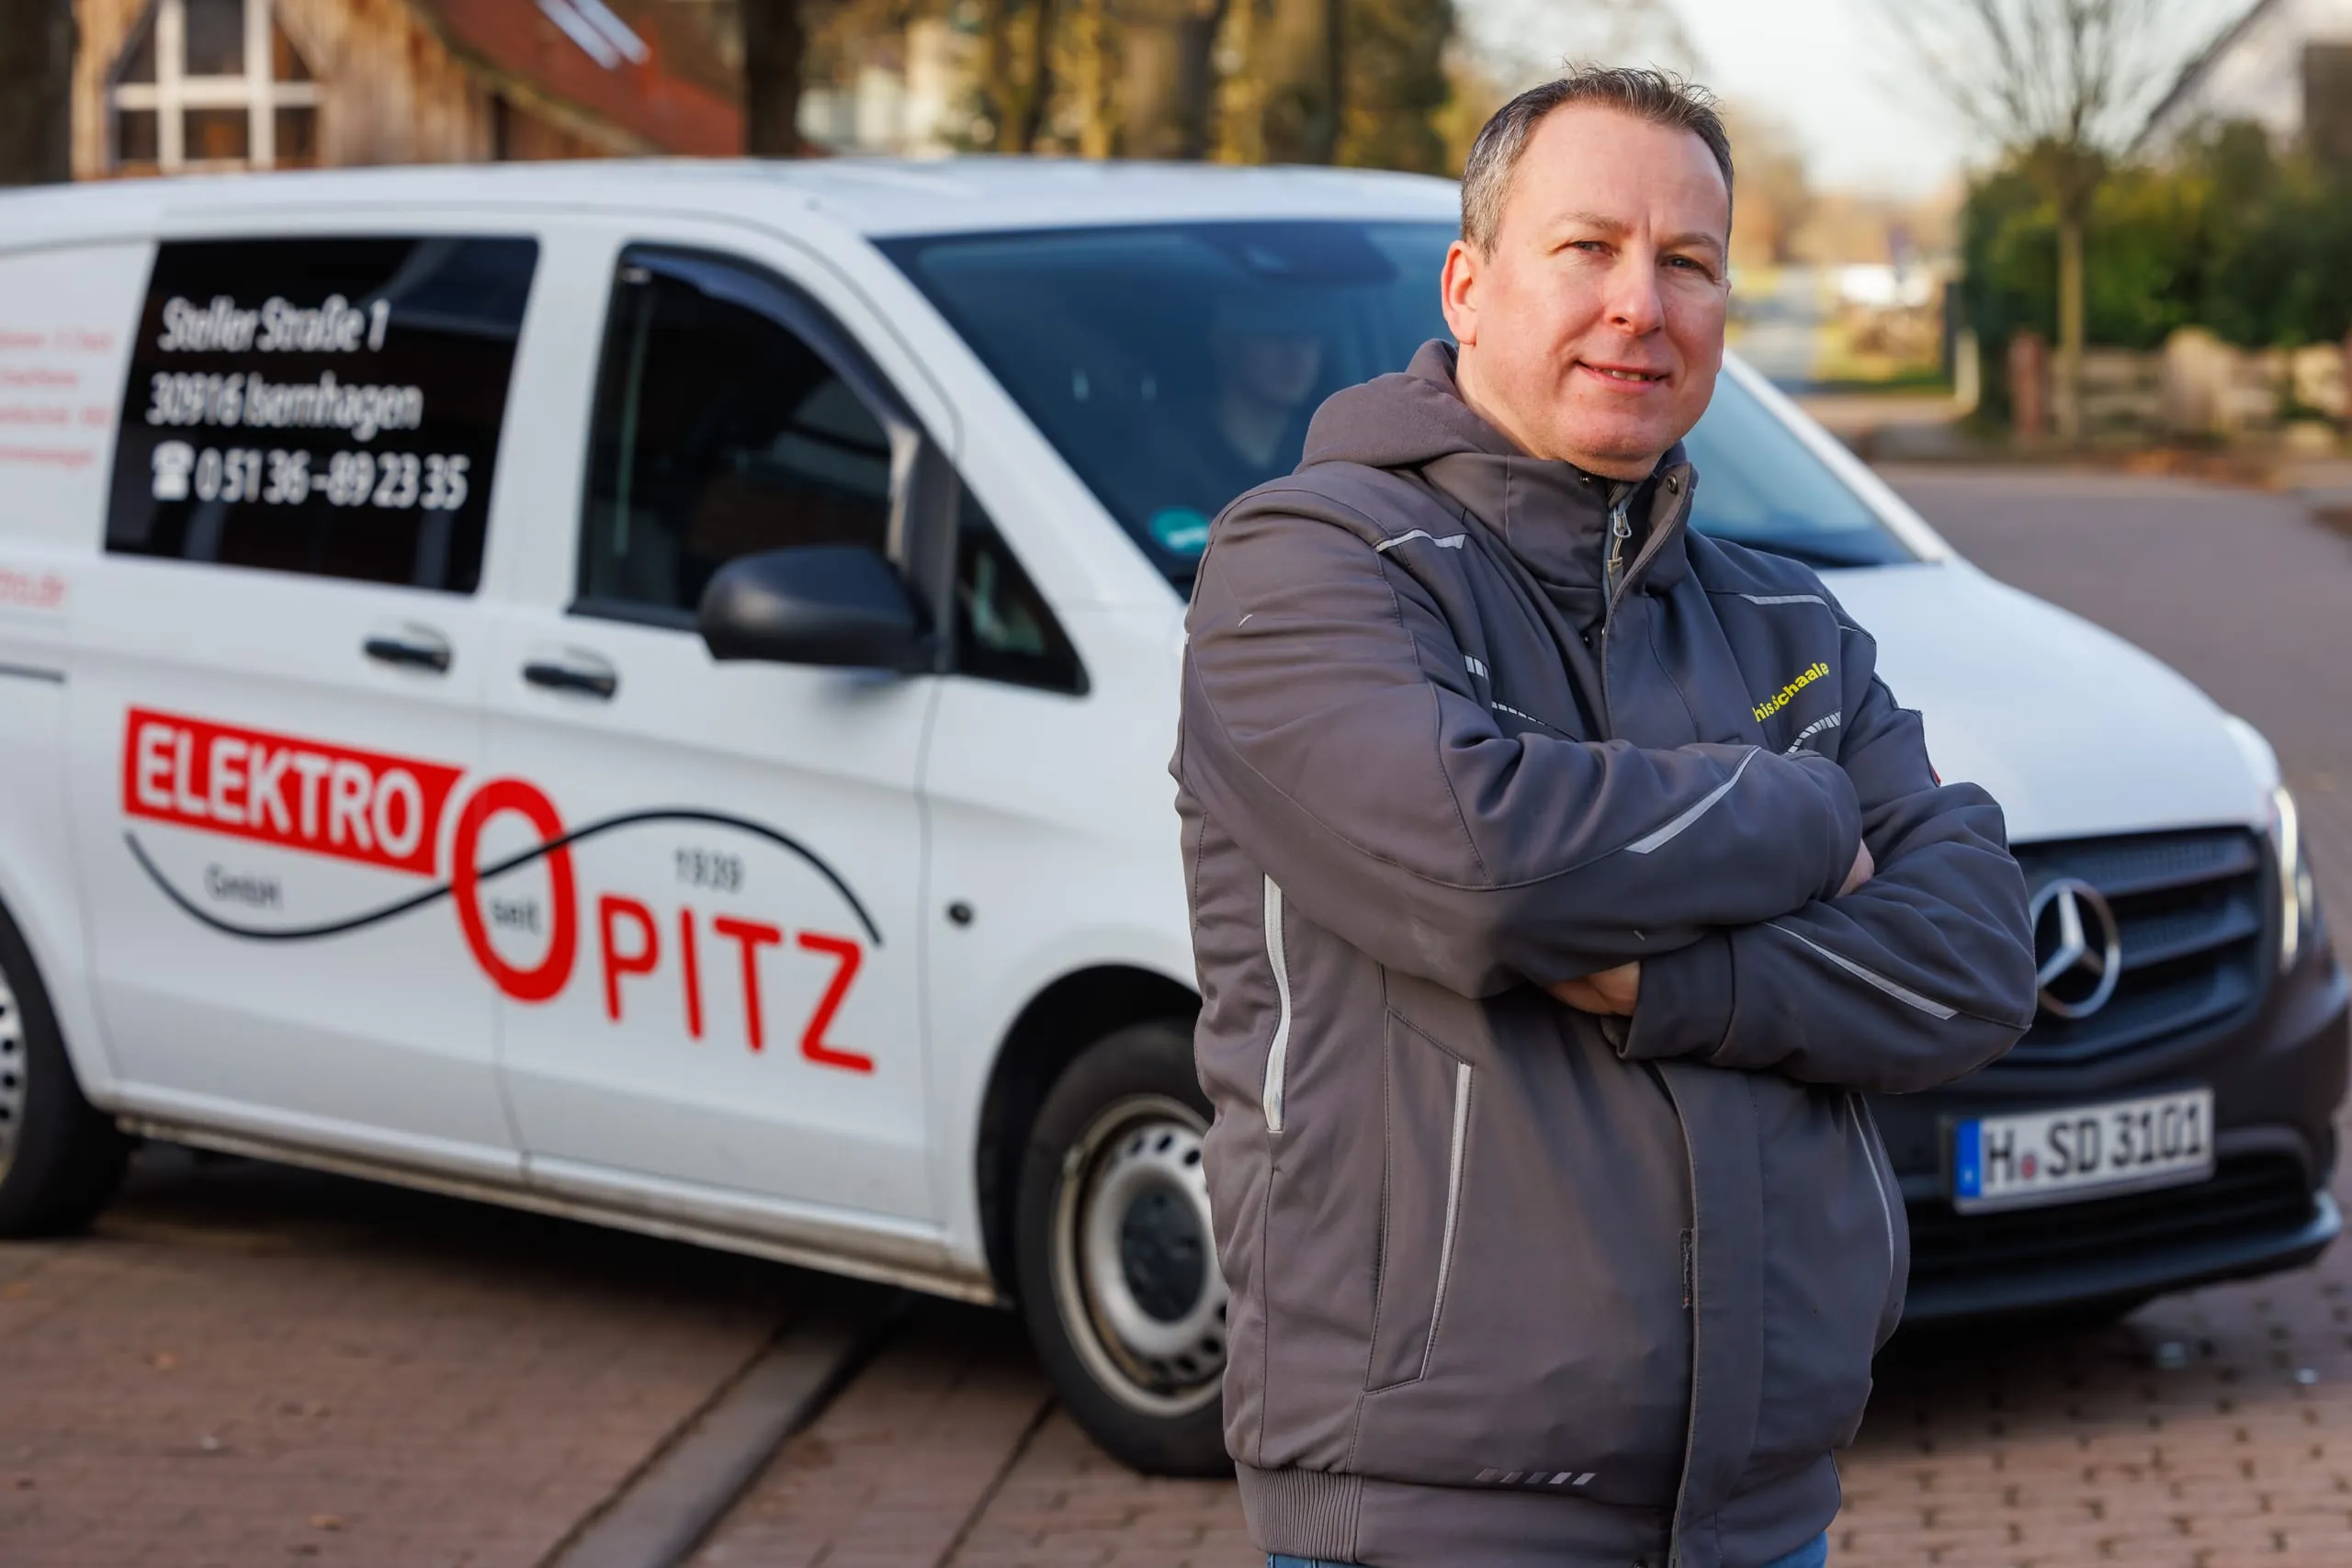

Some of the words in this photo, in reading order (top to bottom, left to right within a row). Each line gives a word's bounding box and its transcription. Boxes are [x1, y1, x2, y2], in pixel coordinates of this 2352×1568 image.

[255, 294, 366, 352] Straße
[368, 299, 391, 352] 1
[145, 371, 246, 426] 30916
[243, 369, 424, 442] Isernhagen
[134, 722, 425, 858] ELEKTRO
[673, 848, 746, 894] 1939
[490, 897, 542, 936] seit
[1986, 1127, 2016, 1185] H
[2047, 1117, 2102, 1178] SD
[2111, 1103, 2201, 1168] 3101
